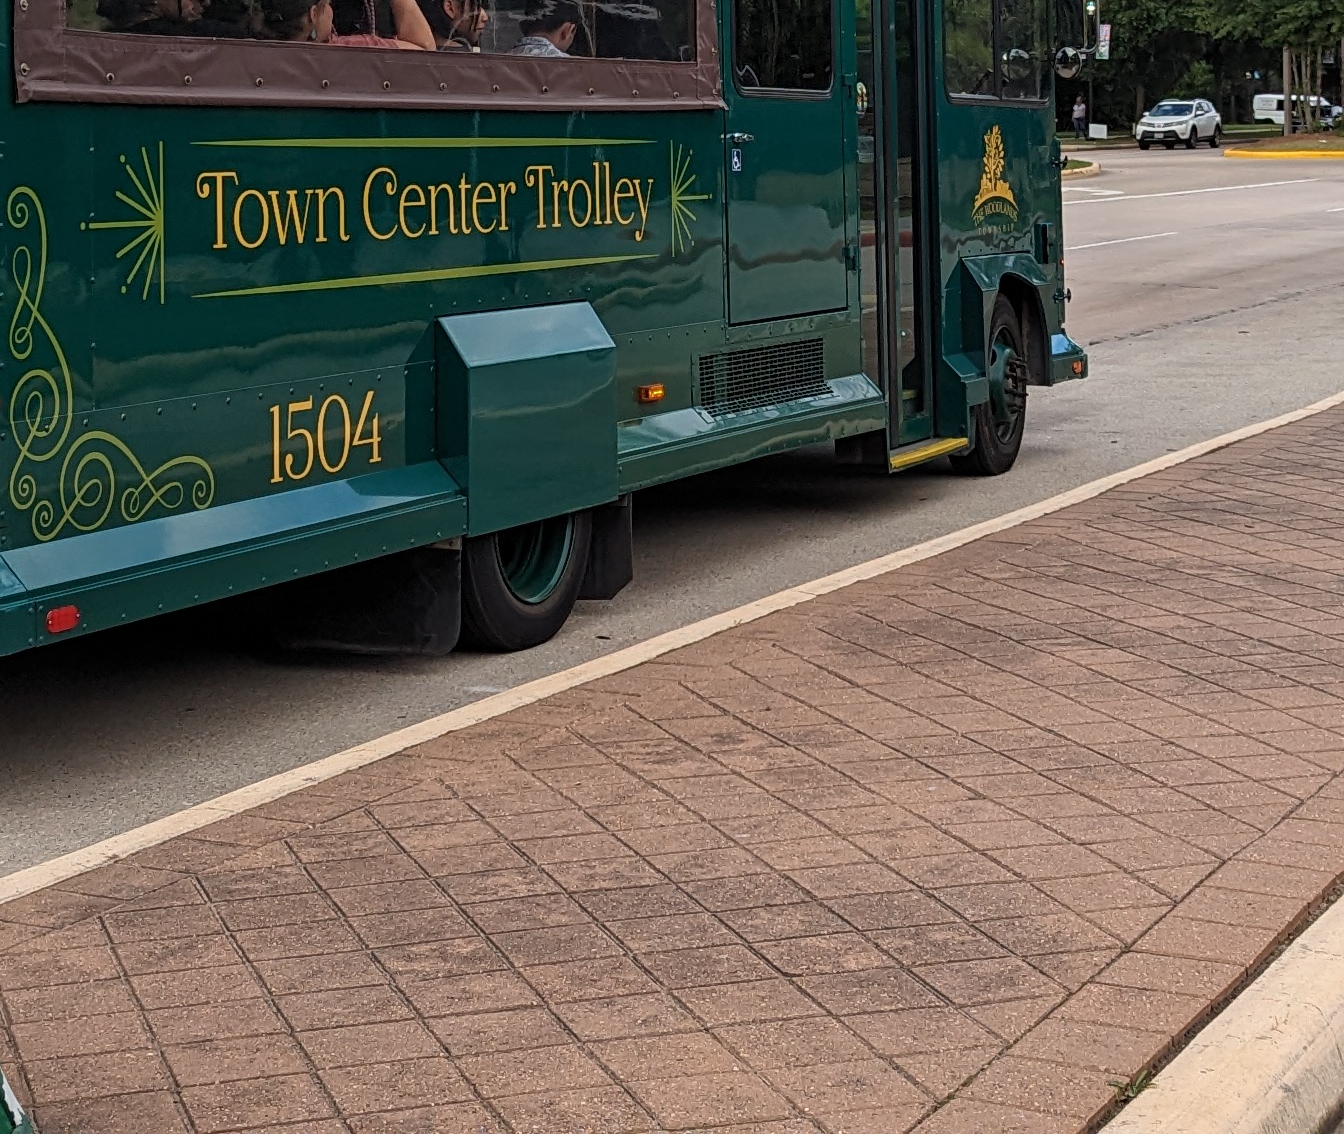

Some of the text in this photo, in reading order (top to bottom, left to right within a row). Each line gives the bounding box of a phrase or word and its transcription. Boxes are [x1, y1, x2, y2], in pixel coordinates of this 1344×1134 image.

[196, 161, 654, 250] Town Center Trolley
[268, 390, 383, 484] 1504
